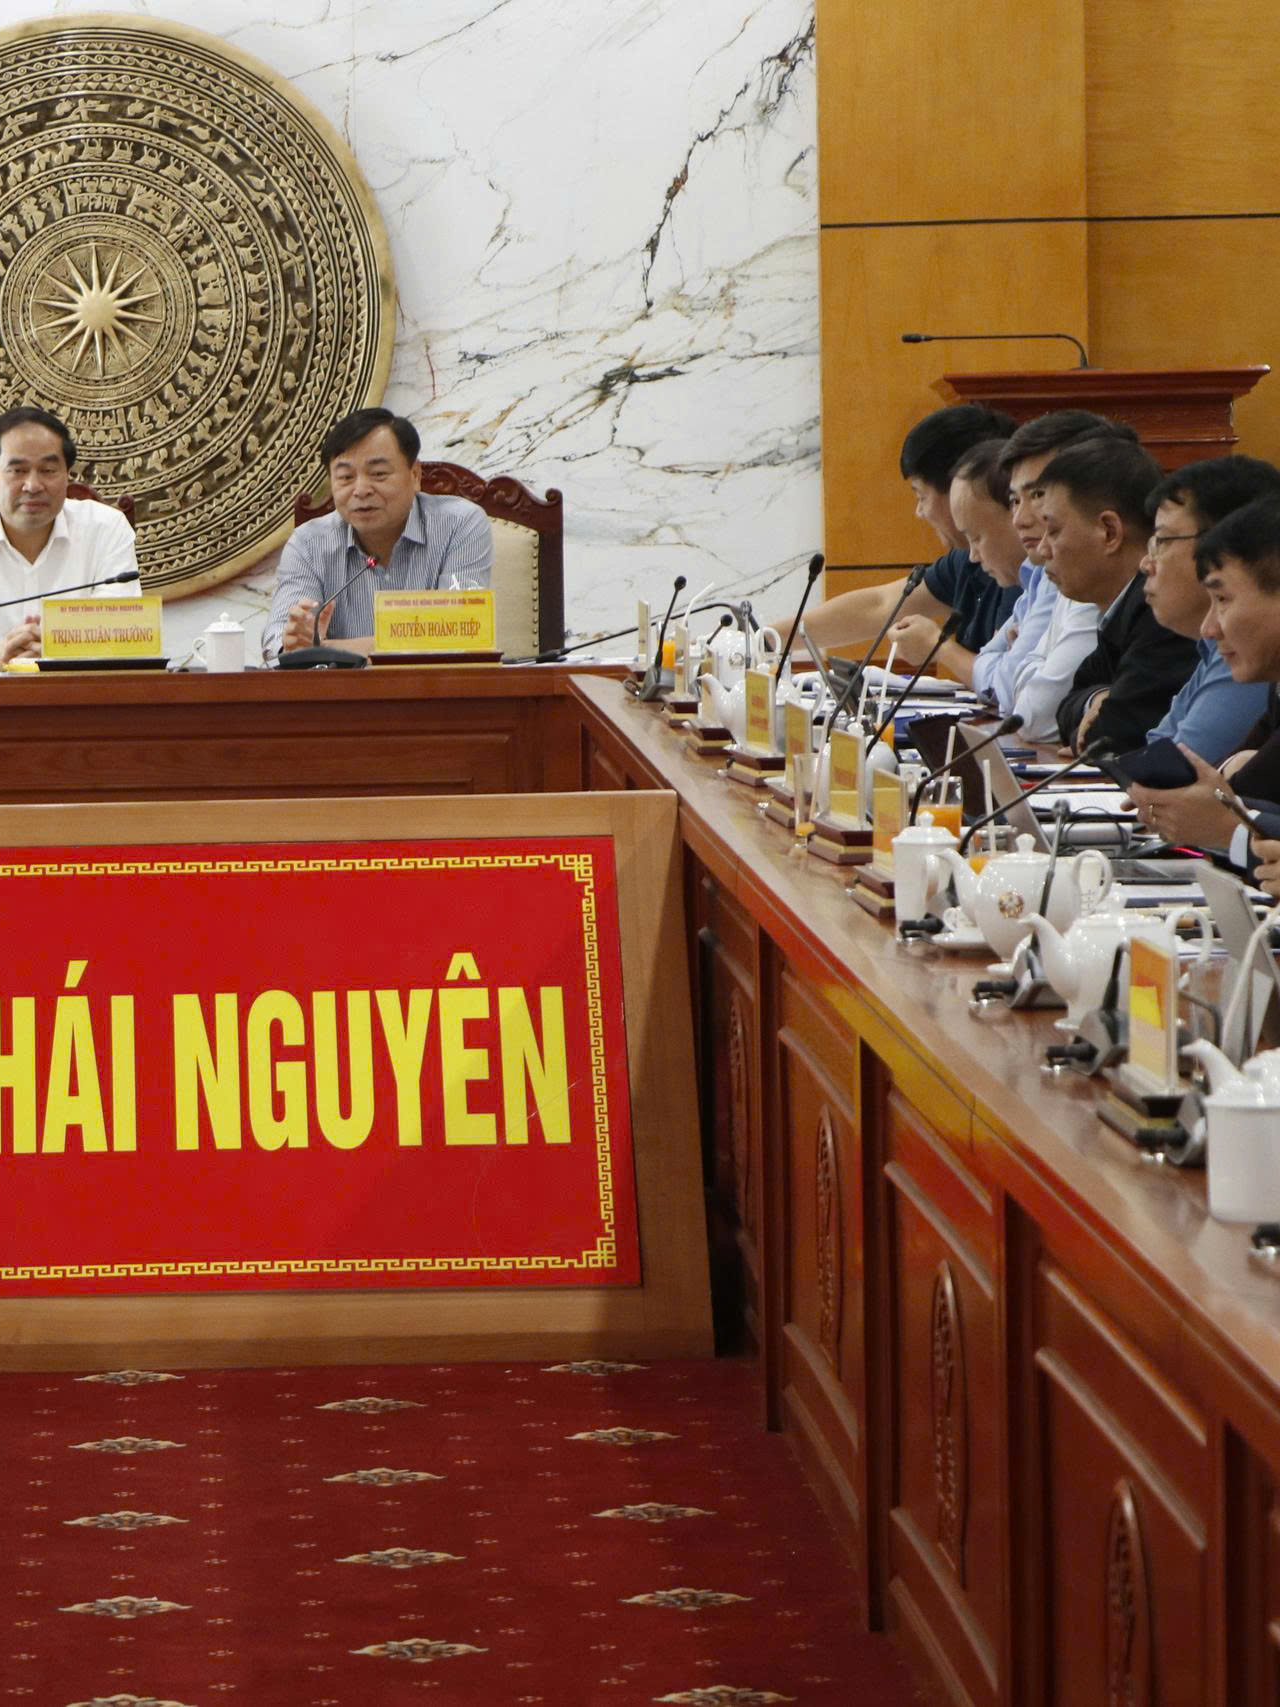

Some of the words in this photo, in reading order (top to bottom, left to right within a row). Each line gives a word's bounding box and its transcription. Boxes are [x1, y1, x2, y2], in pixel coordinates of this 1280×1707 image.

[52, 628, 81, 647] TRỊNH
[83, 625, 111, 644] XUÂN
[427, 617, 458, 637] HOÀNG
[460, 616, 481, 639] HIỆP
[174, 953, 571, 1150] NGUYÊN
